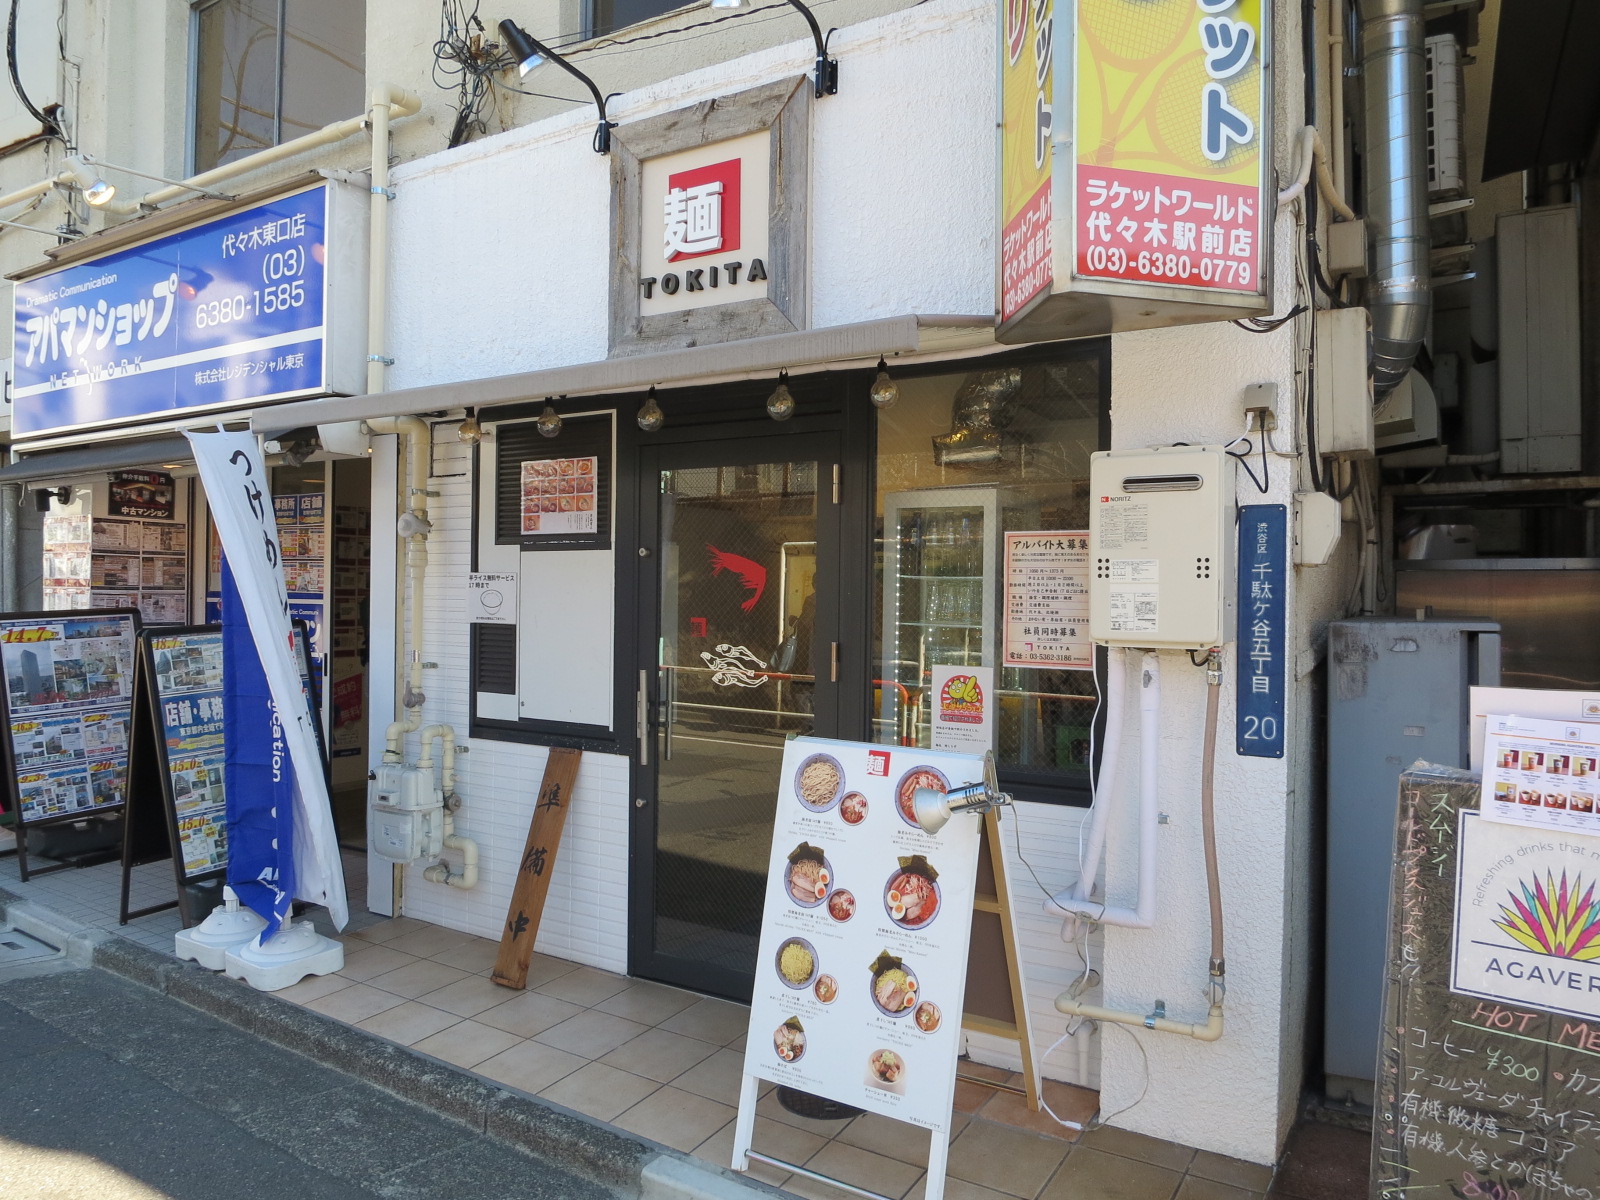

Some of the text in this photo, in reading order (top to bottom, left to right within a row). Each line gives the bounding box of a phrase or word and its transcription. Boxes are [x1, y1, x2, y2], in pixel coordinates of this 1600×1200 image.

[1032, 0, 1052, 169] ット
[1197, 0, 1255, 161] ット
[664, 181, 723, 260] 麺
[1086, 178, 1253, 224] ラケットワールド
[222, 213, 306, 261] 代々木東口店
[1086, 210, 1252, 258] 代々木駅前店
[262, 245, 306, 285] (03)
[640, 258, 768, 299] TOKITA
[1086, 244, 1251, 285] (03)-6380-0779
[26, 272, 118, 308] Dramatic Communication
[195, 280, 306, 330] 6380-1585
[25, 272, 179, 368] アパマンショップ
[194, 352, 306, 387] 株式会社レジデンシャル東京
[121, 506, 169, 517] 中古マンション
[301, 496, 323, 509] 店舗
[1013, 539, 1089, 550] アルバイト大募集
[1257, 522, 1268, 554] 渋谷区
[4, 627, 47, 643] 14.7
[1023, 626, 1077, 637] 社員同時募集
[1244, 716, 1277, 740] 20
[867, 754, 886, 776] 麺
[1429, 793, 1455, 877] スムージー
[1472, 854, 1515, 907] Refreshing
[1516, 841, 1554, 857] drinks
[1559, 841, 1586, 855] that
[1471, 1002, 1538, 1032] HOT
[1411, 1027, 1476, 1058] コーヒー
[1487, 1046, 1539, 1081] ¥300
